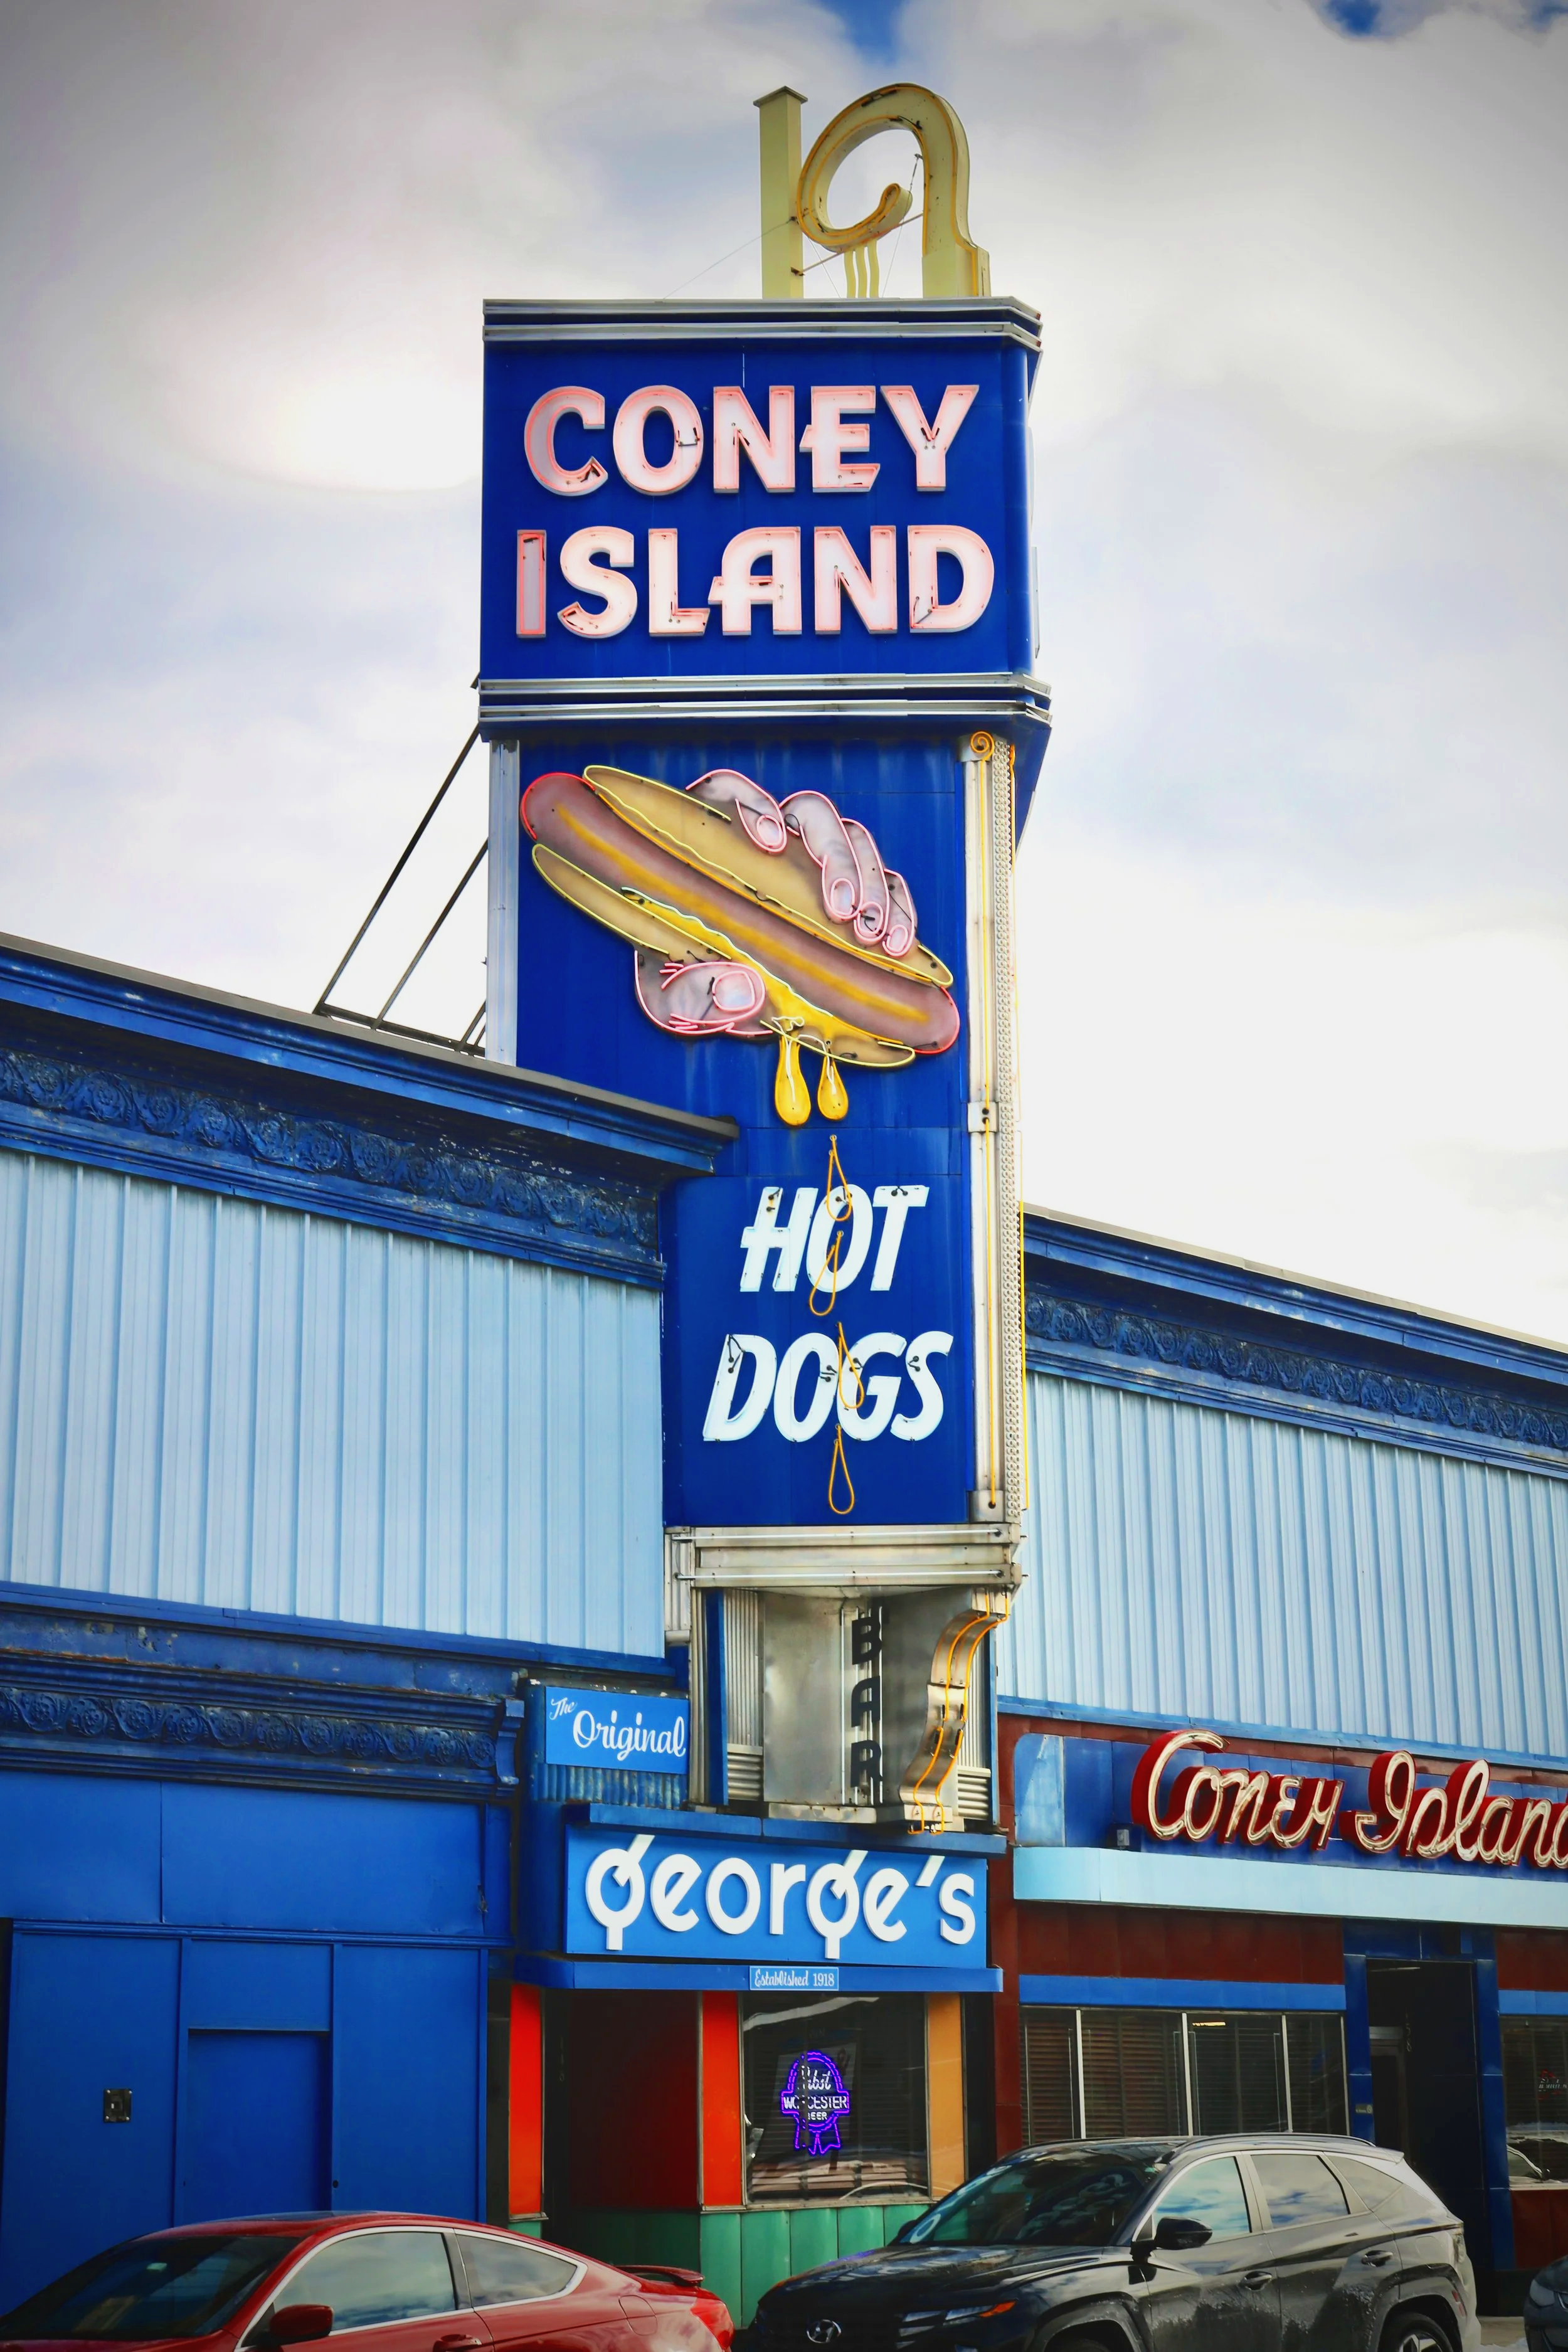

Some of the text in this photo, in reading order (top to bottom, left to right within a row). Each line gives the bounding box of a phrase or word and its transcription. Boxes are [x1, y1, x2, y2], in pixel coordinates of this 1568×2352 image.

[524, 384, 980, 496] CONEY
[516, 524, 995, 638] ISLAND
[739, 1184, 930, 1292] HOT
[702, 1331, 954, 1443] DOGS
[549, 1697, 578, 1720] The
[572, 1710, 686, 1761] Original
[850, 1616, 883, 1788] BAR
[1131, 1729, 1345, 1851] Coney
[585, 1835, 976, 1959] George's
[755, 1968, 835, 1988] Established 1918
[783, 2095, 847, 2109] WOCESTER
